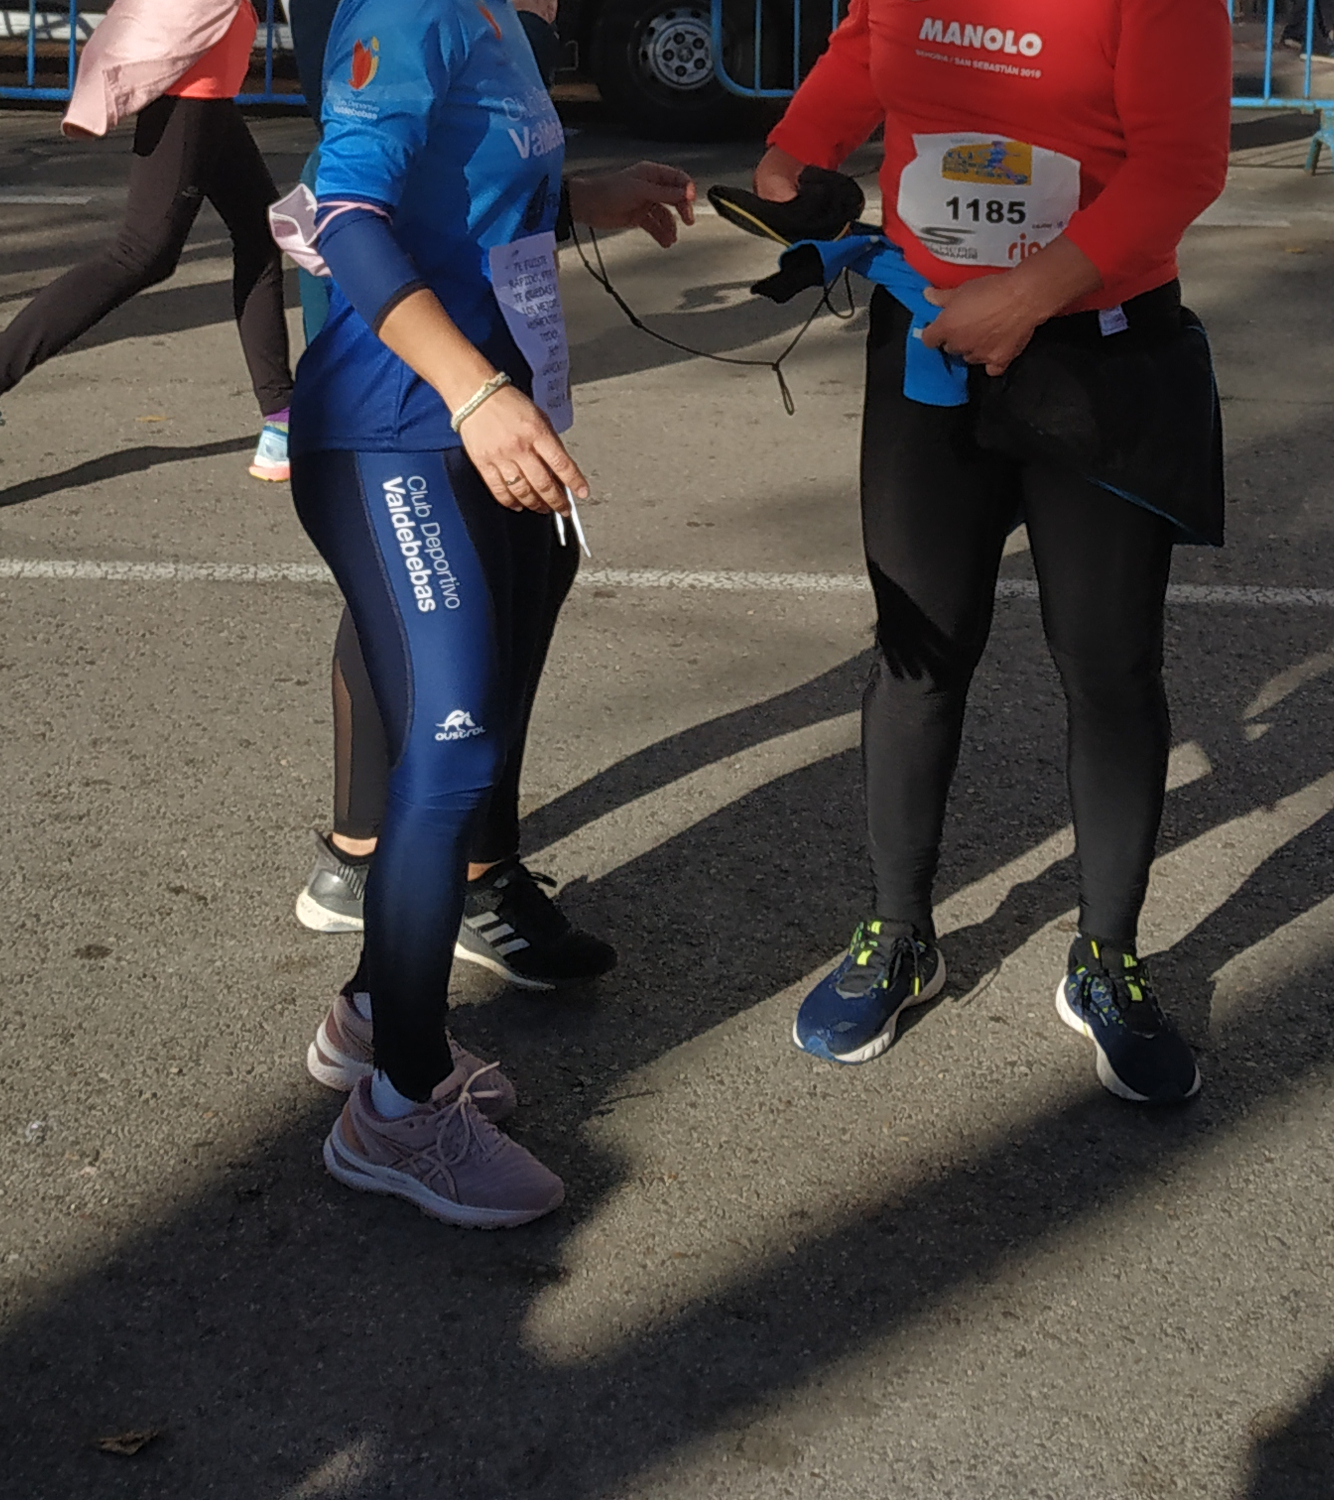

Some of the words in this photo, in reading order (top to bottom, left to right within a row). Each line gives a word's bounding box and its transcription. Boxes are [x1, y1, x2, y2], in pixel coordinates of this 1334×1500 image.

[918, 17, 1043, 57] MANOLO
[946, 196, 1027, 225] 1185
[382, 476, 436, 613] Valdebebas
[406, 475, 431, 518] Club
[419, 522, 461, 610] Deportivo
[435, 725, 487, 742] austral
